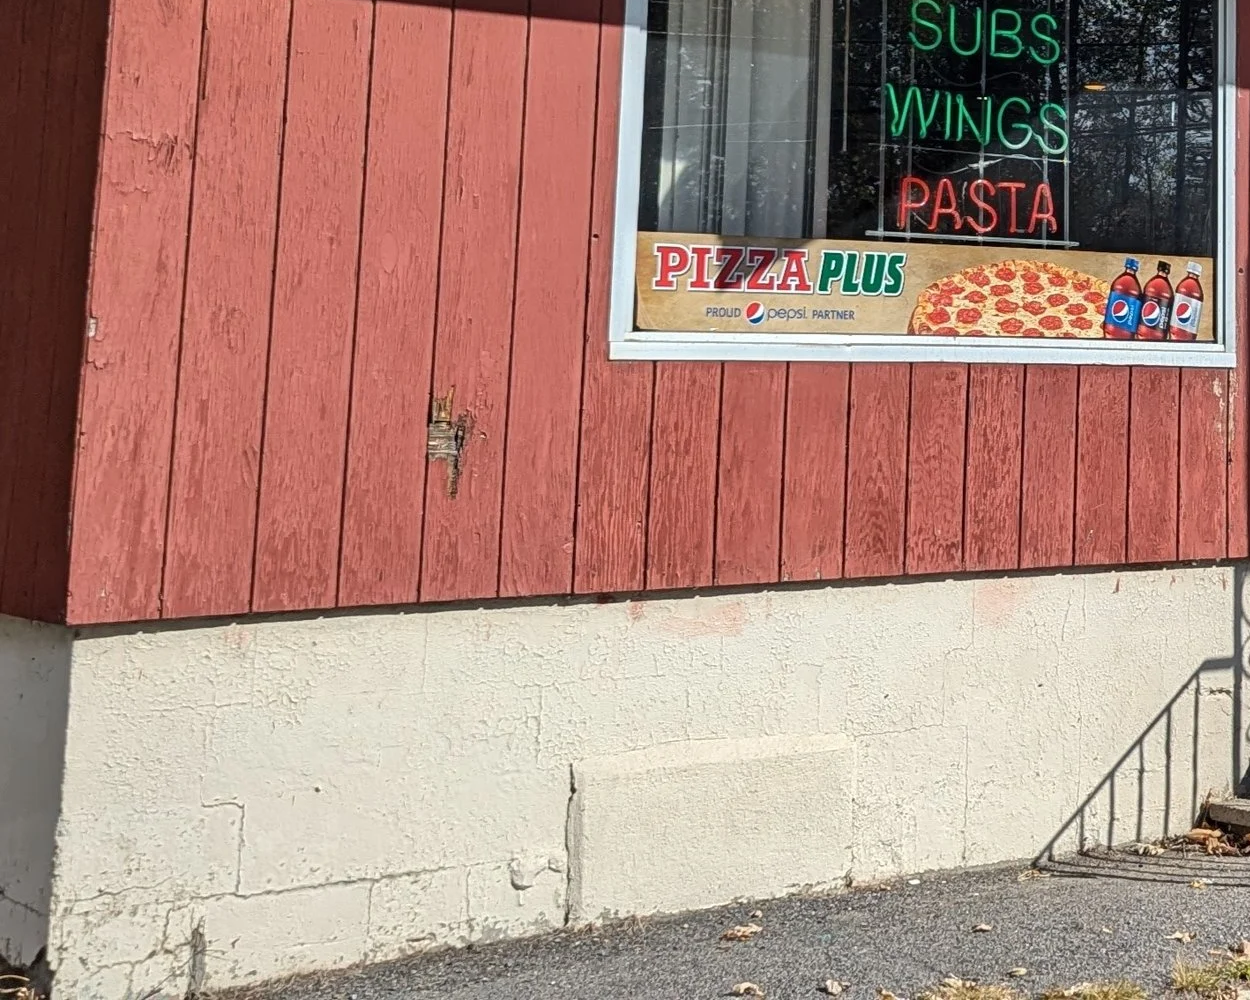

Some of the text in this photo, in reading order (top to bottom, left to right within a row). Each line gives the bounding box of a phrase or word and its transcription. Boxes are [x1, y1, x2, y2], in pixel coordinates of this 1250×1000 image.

[908, 0, 1061, 65] SUBS
[885, 83, 1069, 154] WINGS
[898, 176, 1058, 235] PASTA
[653, 243, 907, 295] PIZZA PLUS
[706, 307, 855, 321] PROUD pepsi PARTNER
